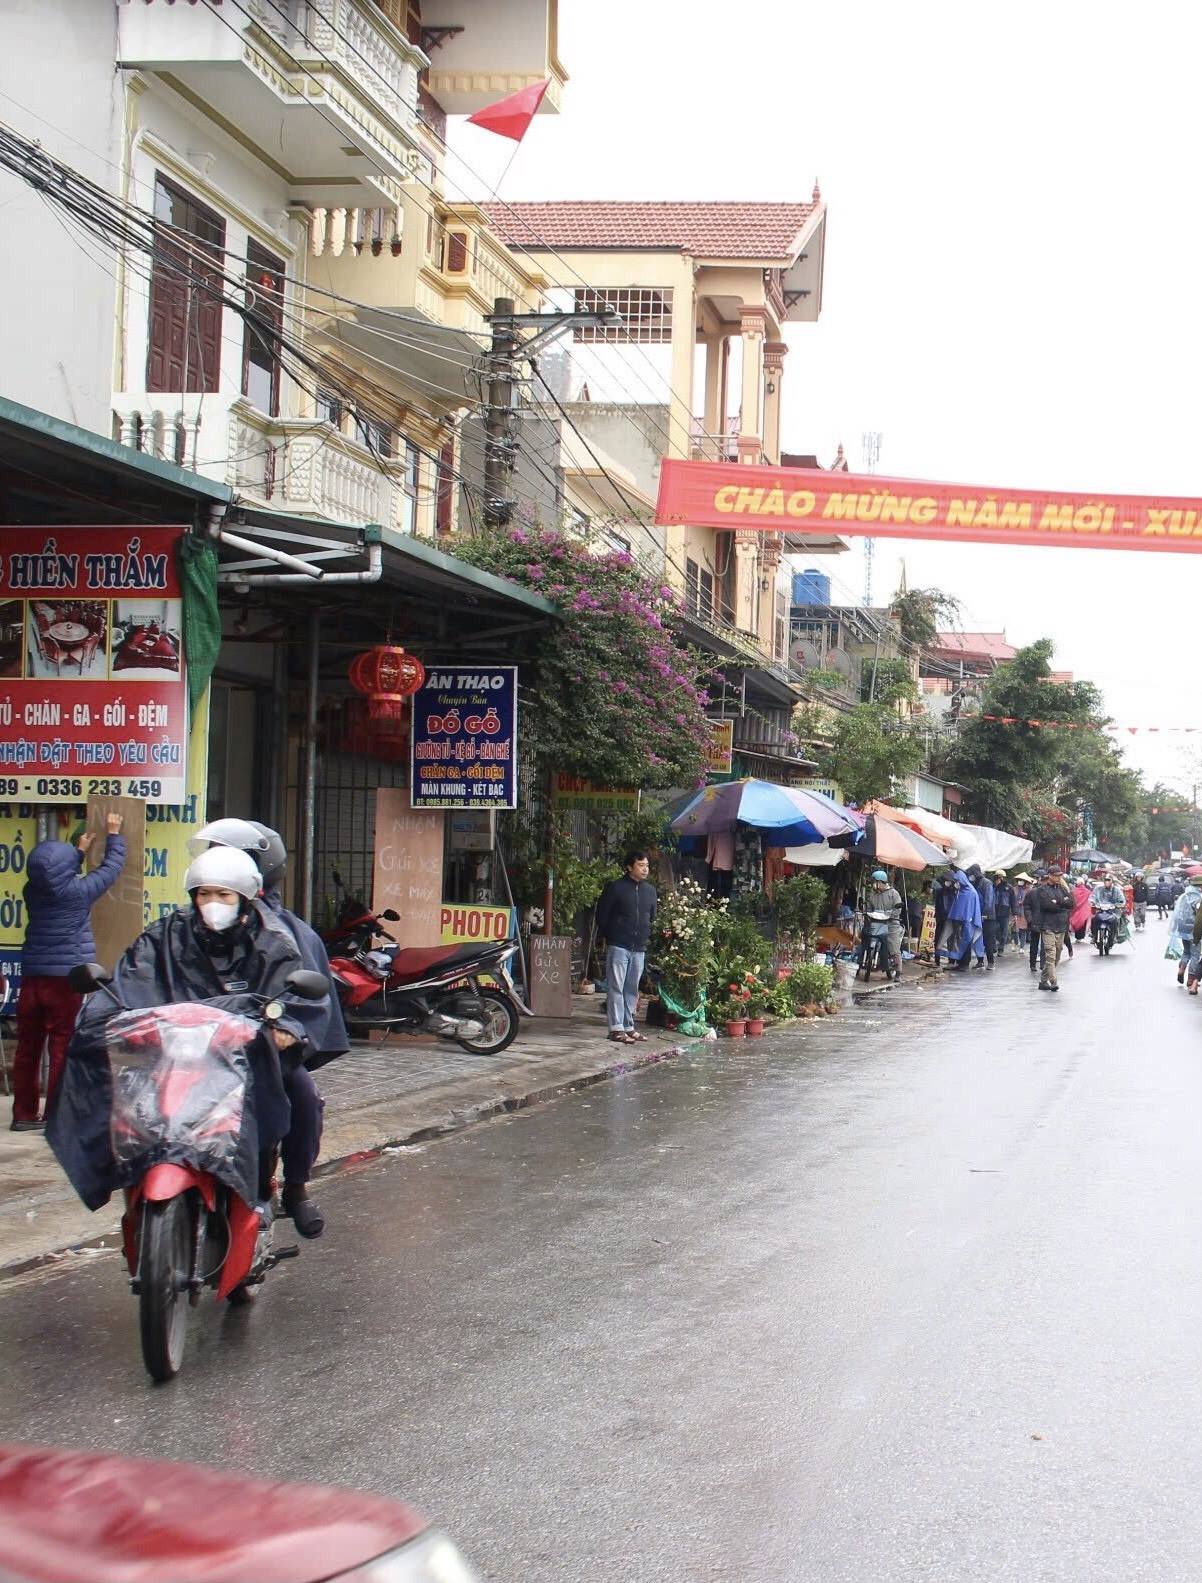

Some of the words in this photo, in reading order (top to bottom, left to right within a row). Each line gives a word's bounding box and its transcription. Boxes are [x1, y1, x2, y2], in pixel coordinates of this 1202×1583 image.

[714, 480, 815, 517] CHÀO
[822, 487, 938, 524] MỪNG
[946, 494, 1032, 530] NĂM
[1039, 500, 1116, 534] MỚI
[84, 537, 168, 590] THẮM
[457, 675, 505, 693] THẠO
[25, 698, 61, 726] CHĂN
[73, 704, 91, 726] GA
[104, 697, 126, 727] GỐI
[138, 700, 168, 731] ĐỆM
[427, 708, 460, 735] ĐỒ
[464, 707, 501, 735] GỖ
[40, 738, 71, 768] ĐẶT
[74, 742, 115, 766] THEO
[119, 739, 147, 766] YÊU
[151, 735, 180, 766] CẦU
[447, 766, 461, 779] GA
[37, 779, 82, 796] 0336
[88, 780, 122, 797] 233
[128, 780, 162, 797] 459
[421, 781, 439, 795] MÀN
[440, 783, 466, 796] KHUNG
[489, 783, 504, 798] BẠC
[440, 908, 508, 939] PHOTO
